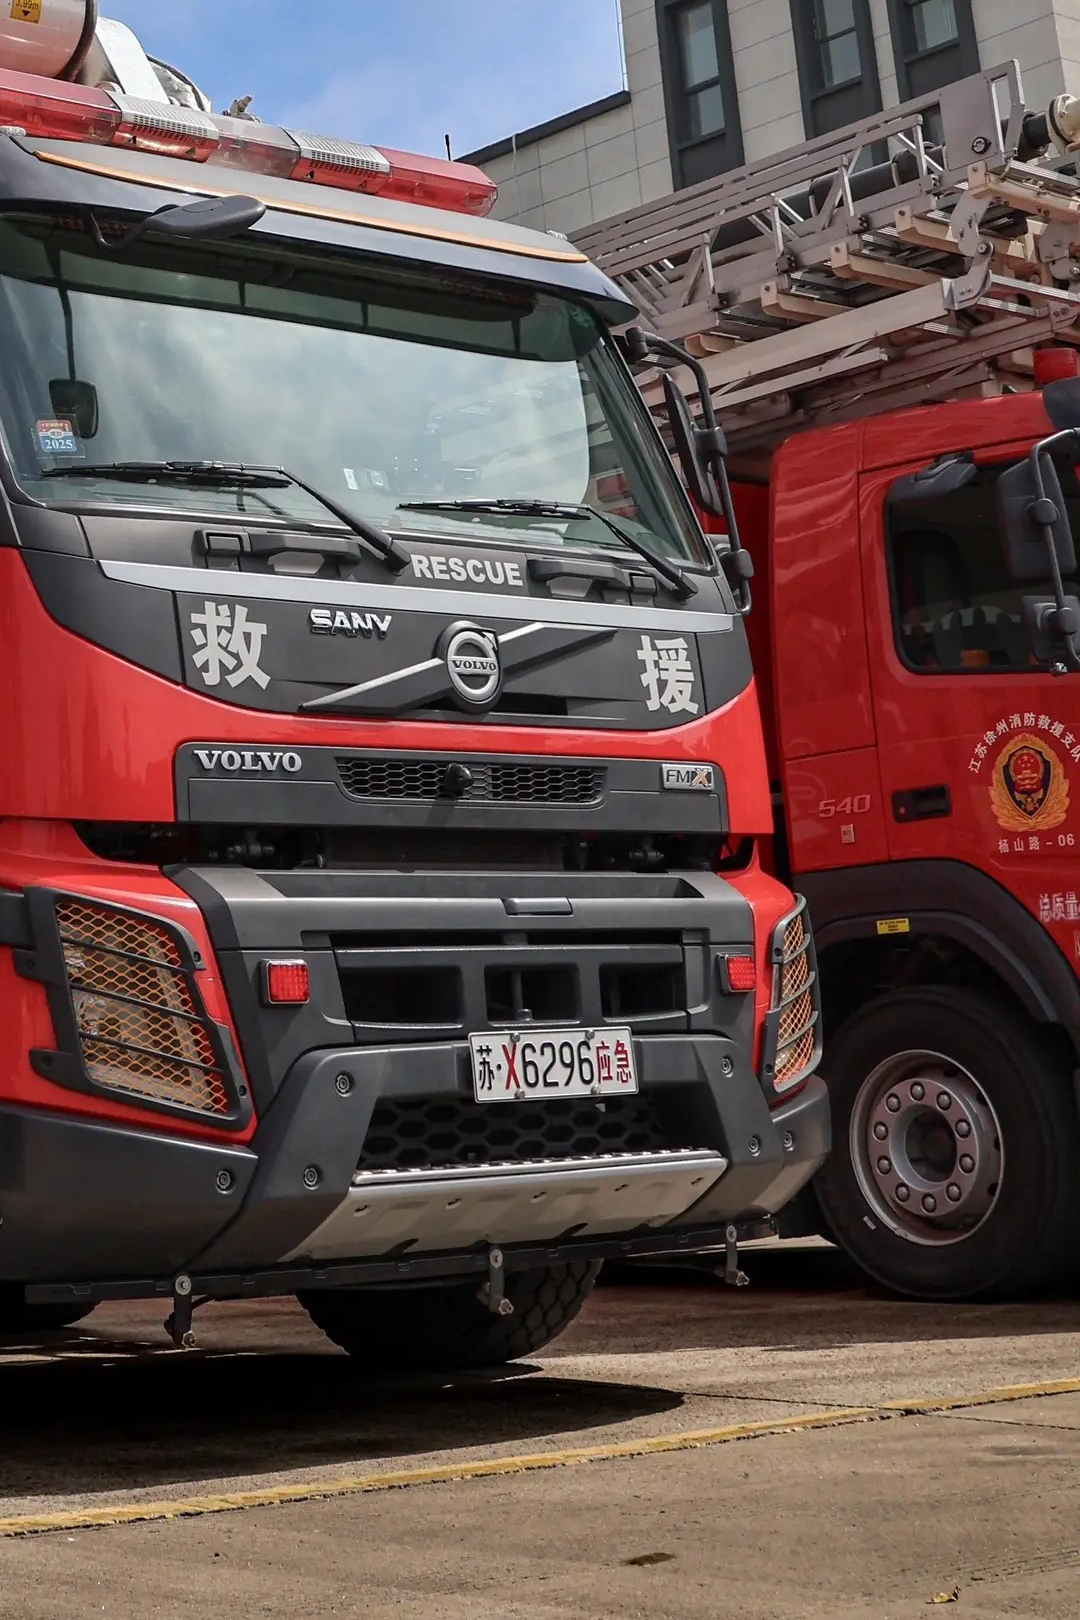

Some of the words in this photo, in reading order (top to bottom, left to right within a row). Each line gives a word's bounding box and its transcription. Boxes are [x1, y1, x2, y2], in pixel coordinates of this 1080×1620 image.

[44, 439, 73, 449] 2025
[412, 553, 524, 586] RESCUE
[310, 608, 392, 637] SANY
[190, 600, 271, 690] 救
[637, 635, 699, 715] 援
[451, 659, 496, 672] VOLVO
[968, 712, 1080, 774] 江苏徐州消防救援支队
[194, 750, 302, 772] VOLVO
[666, 768, 712, 787] FMX
[819, 794, 870, 818] 540
